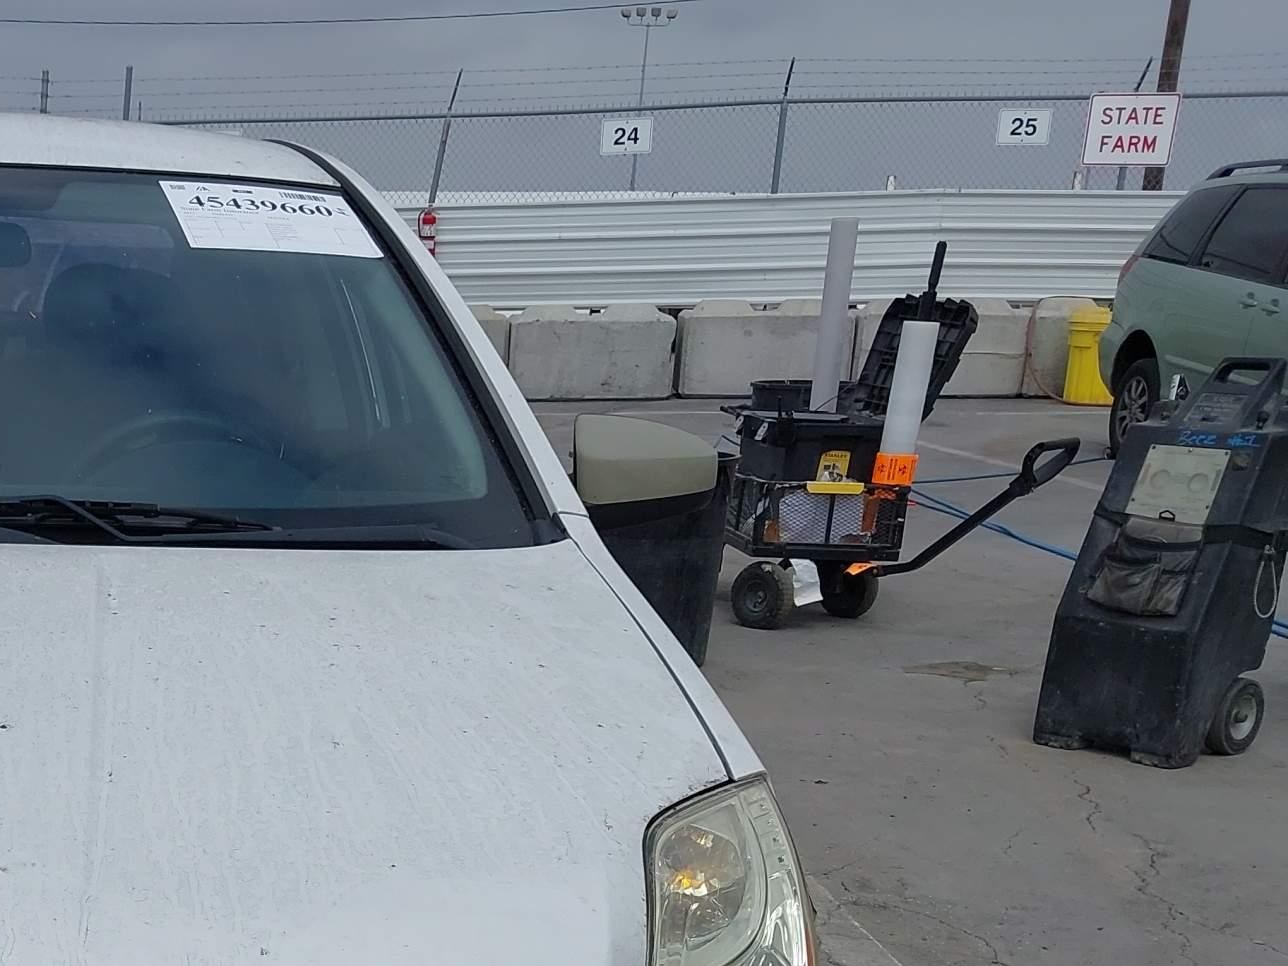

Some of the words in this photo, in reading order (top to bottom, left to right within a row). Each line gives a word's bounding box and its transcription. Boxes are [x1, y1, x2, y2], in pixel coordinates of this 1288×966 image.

[1099, 106, 1166, 126] STATE
[613, 127, 640, 146] 24
[1009, 117, 1038, 137] 25
[1098, 135, 1158, 154] FARM
[188, 194, 333, 217] 45439660
